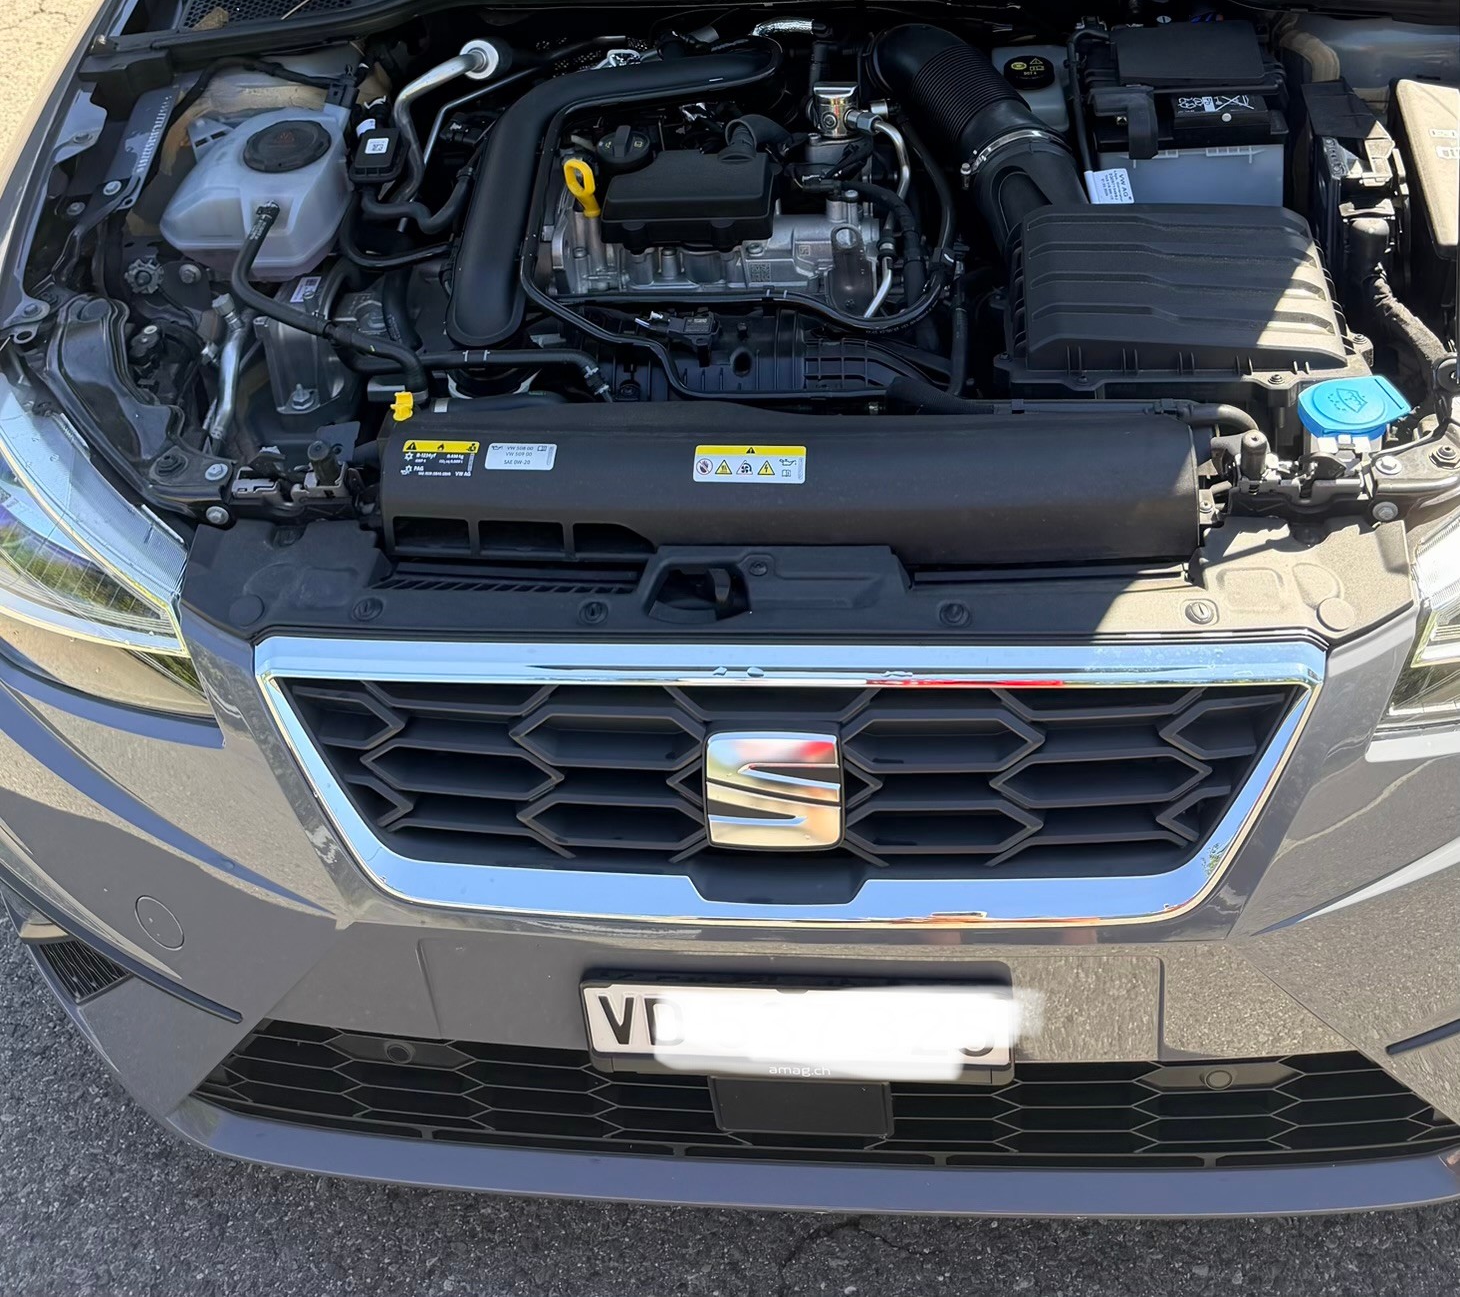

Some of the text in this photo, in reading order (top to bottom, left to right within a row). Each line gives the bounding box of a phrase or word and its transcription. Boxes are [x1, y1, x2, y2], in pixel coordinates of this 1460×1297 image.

[1119, 173, 1129, 198] VW AG
[768, 1065, 831, 1078] amag.ch
